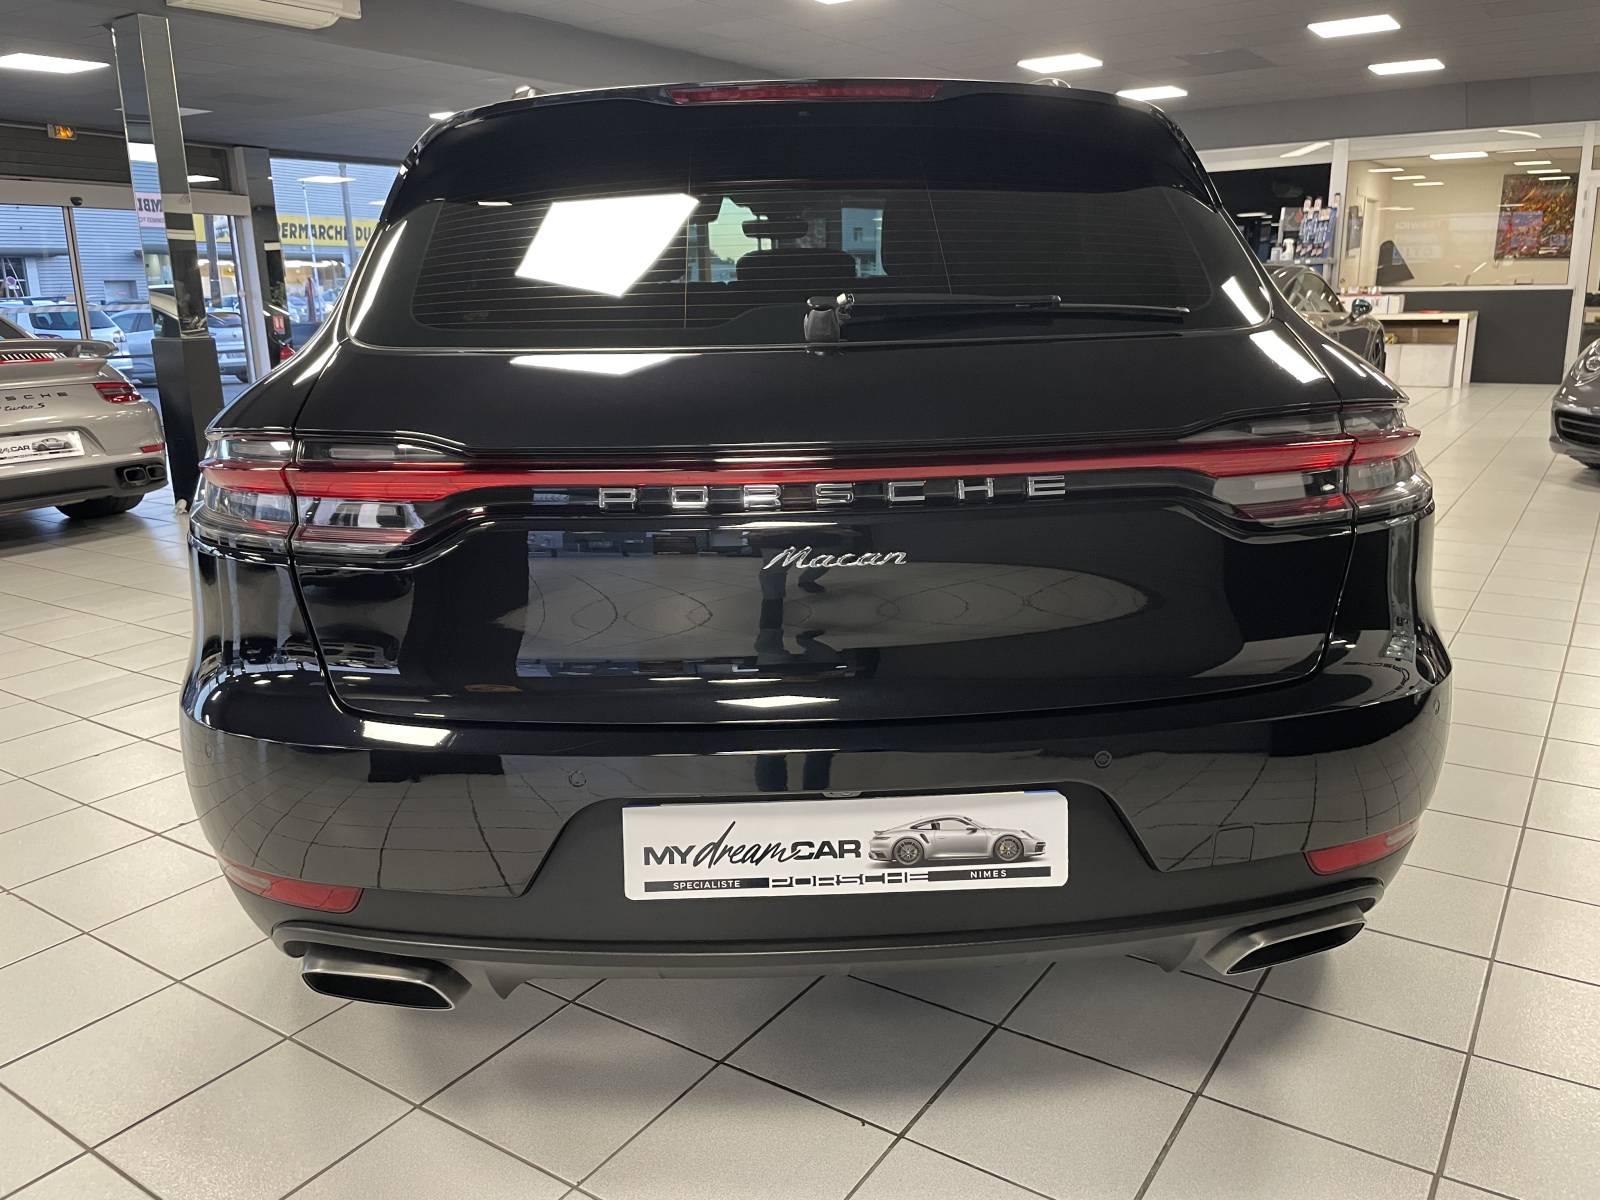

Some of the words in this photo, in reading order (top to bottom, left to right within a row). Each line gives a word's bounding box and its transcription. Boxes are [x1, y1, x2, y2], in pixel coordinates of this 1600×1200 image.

[598, 475, 1066, 511] PORSCHE
[762, 545, 907, 571] Macan
[672, 880, 740, 890] SPECIALISTE
[769, 871, 929, 888] PORSCHE
[970, 869, 1008, 879] NIMES
